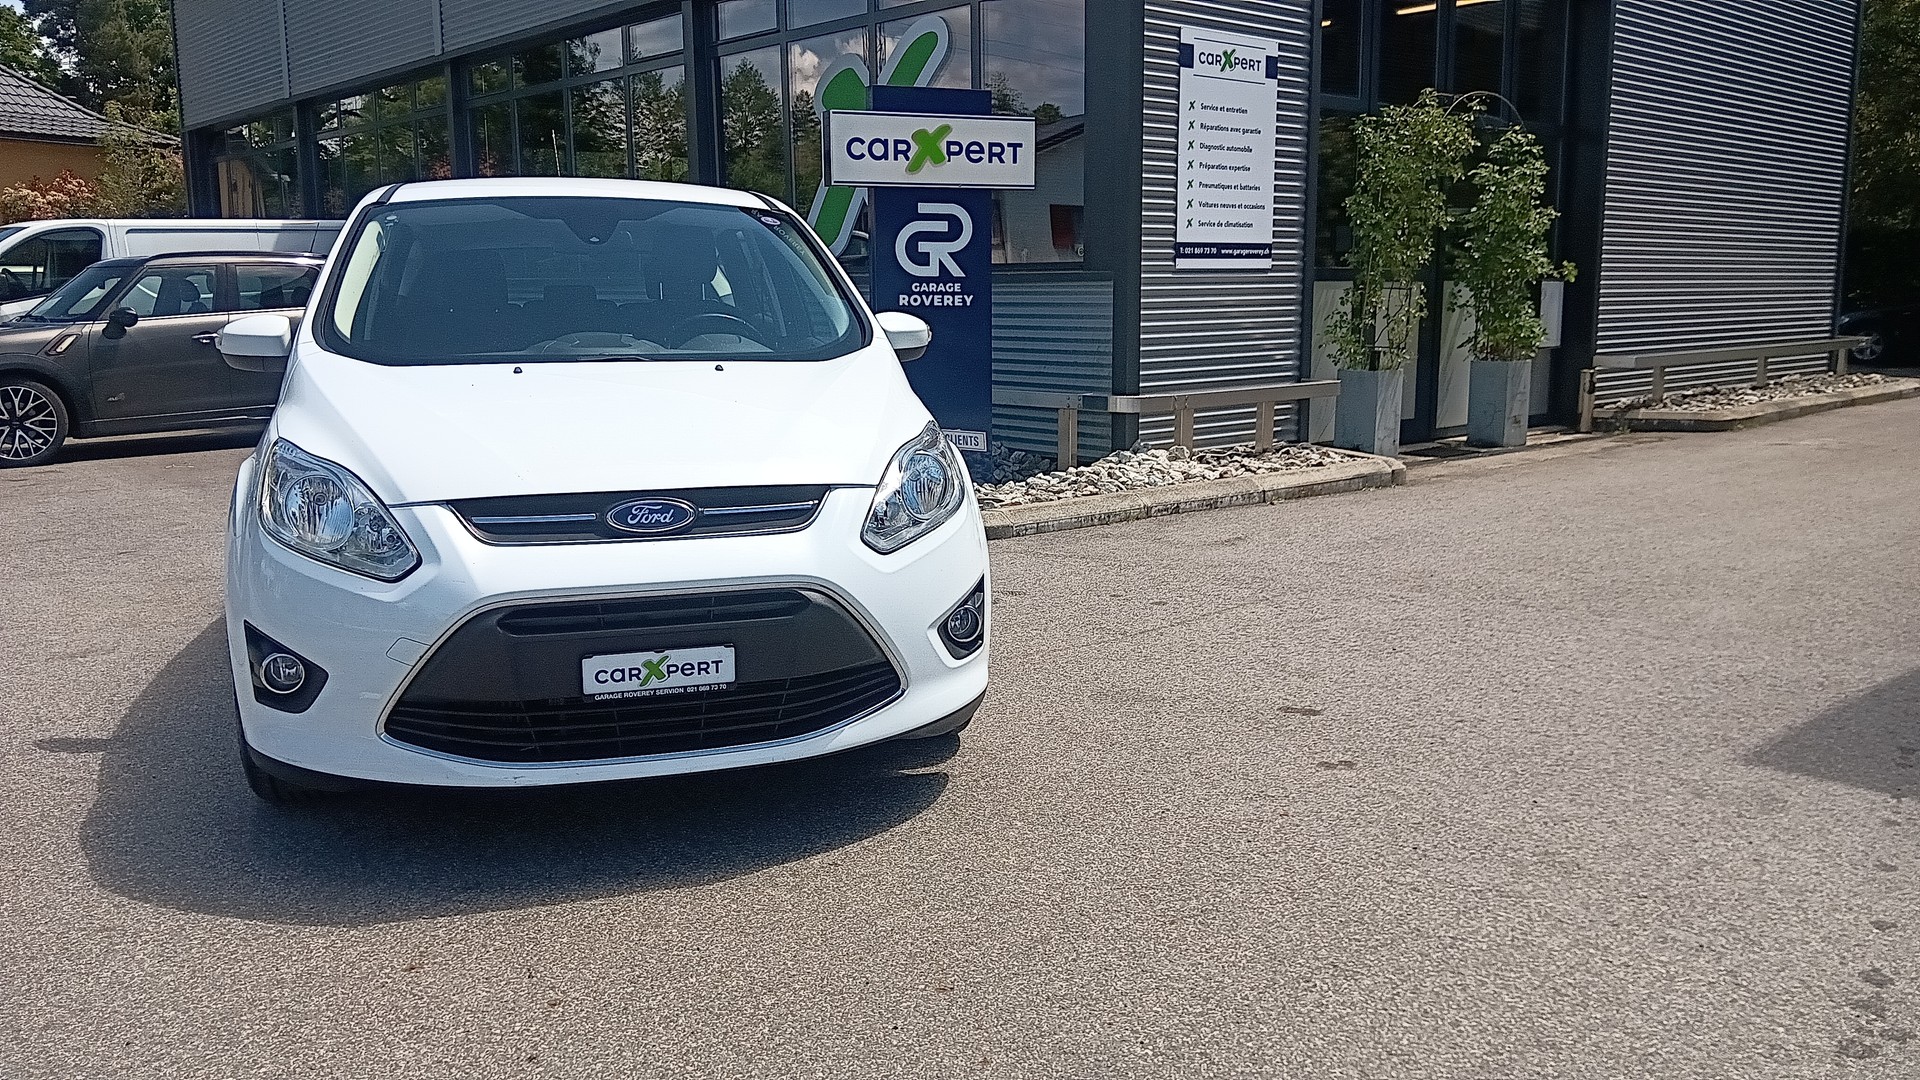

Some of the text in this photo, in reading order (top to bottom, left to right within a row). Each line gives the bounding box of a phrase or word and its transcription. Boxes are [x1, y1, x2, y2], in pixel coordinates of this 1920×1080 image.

[1200, 102, 1219, 111] Service
[1226, 106, 1248, 115] entretien
[1200, 122, 1229, 132] Réparations
[1241, 127, 1262, 136] garantie
[1199, 142, 1253, 153] Diagnostic automobile
[1199, 161, 1251, 173] Préparation expertise
[1198, 181, 1233, 191] Pneumatiques
[1240, 182, 1261, 191] batteries
[1198, 200, 1219, 208] Voitures
[1243, 202, 1266, 210] occasions
[1198, 219, 1254, 228] Service de climatisation
[911, 283, 962, 293] GARAGE
[899, 295, 974, 306] ROVEREY
[627, 504, 675, 525] Ford
[594, 692, 623, 700] GARAGE
[623, 690, 655, 698] ROVEREY
[655, 687, 685, 696] SERVION
